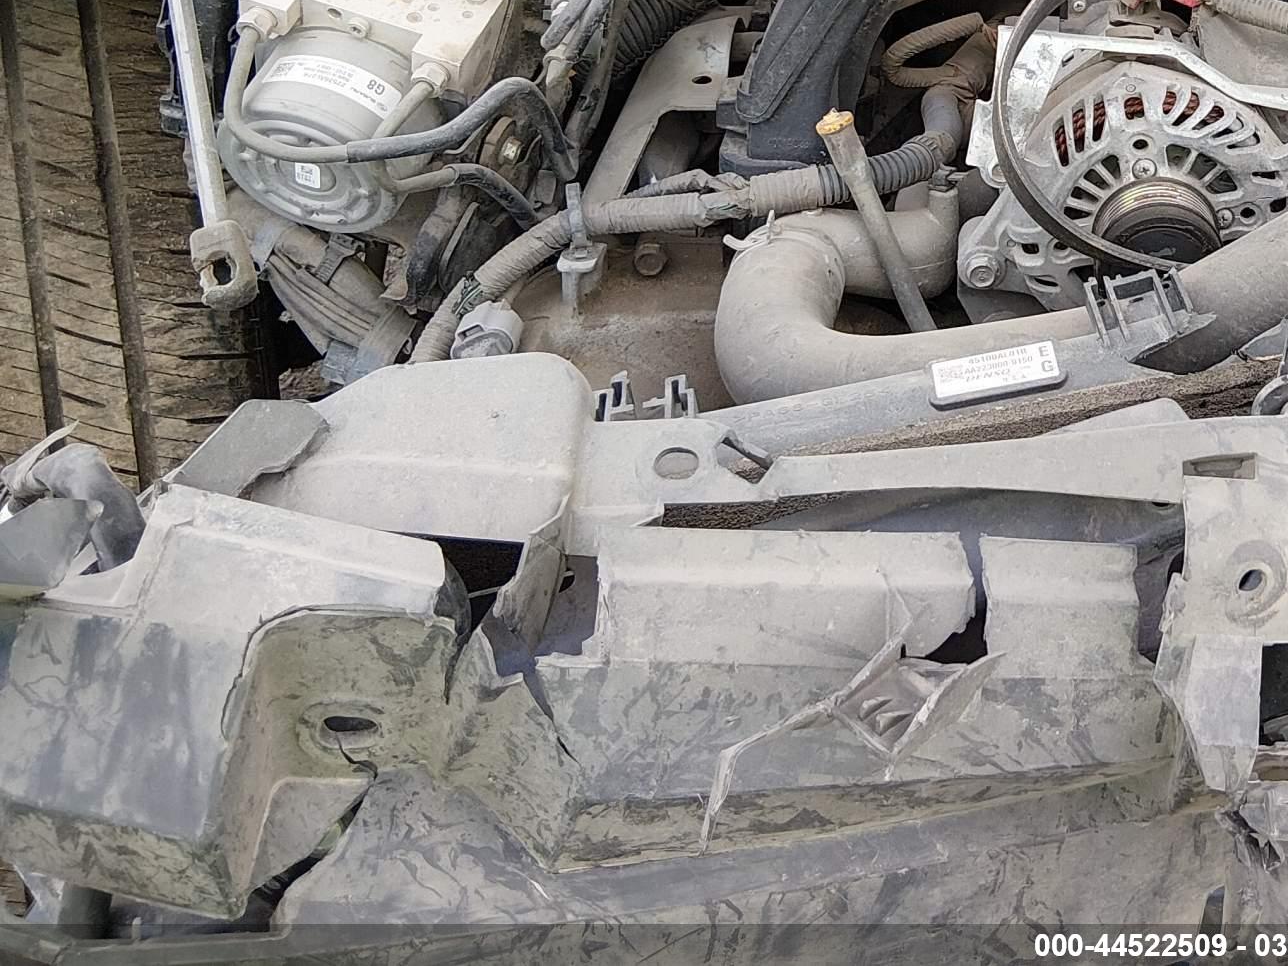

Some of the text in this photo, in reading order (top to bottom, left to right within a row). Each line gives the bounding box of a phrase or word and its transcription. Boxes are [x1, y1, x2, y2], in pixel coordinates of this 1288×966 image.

[366, 79, 385, 95] G8
[1038, 345, 1050, 357] E
[1041, 360, 1054, 372] G
